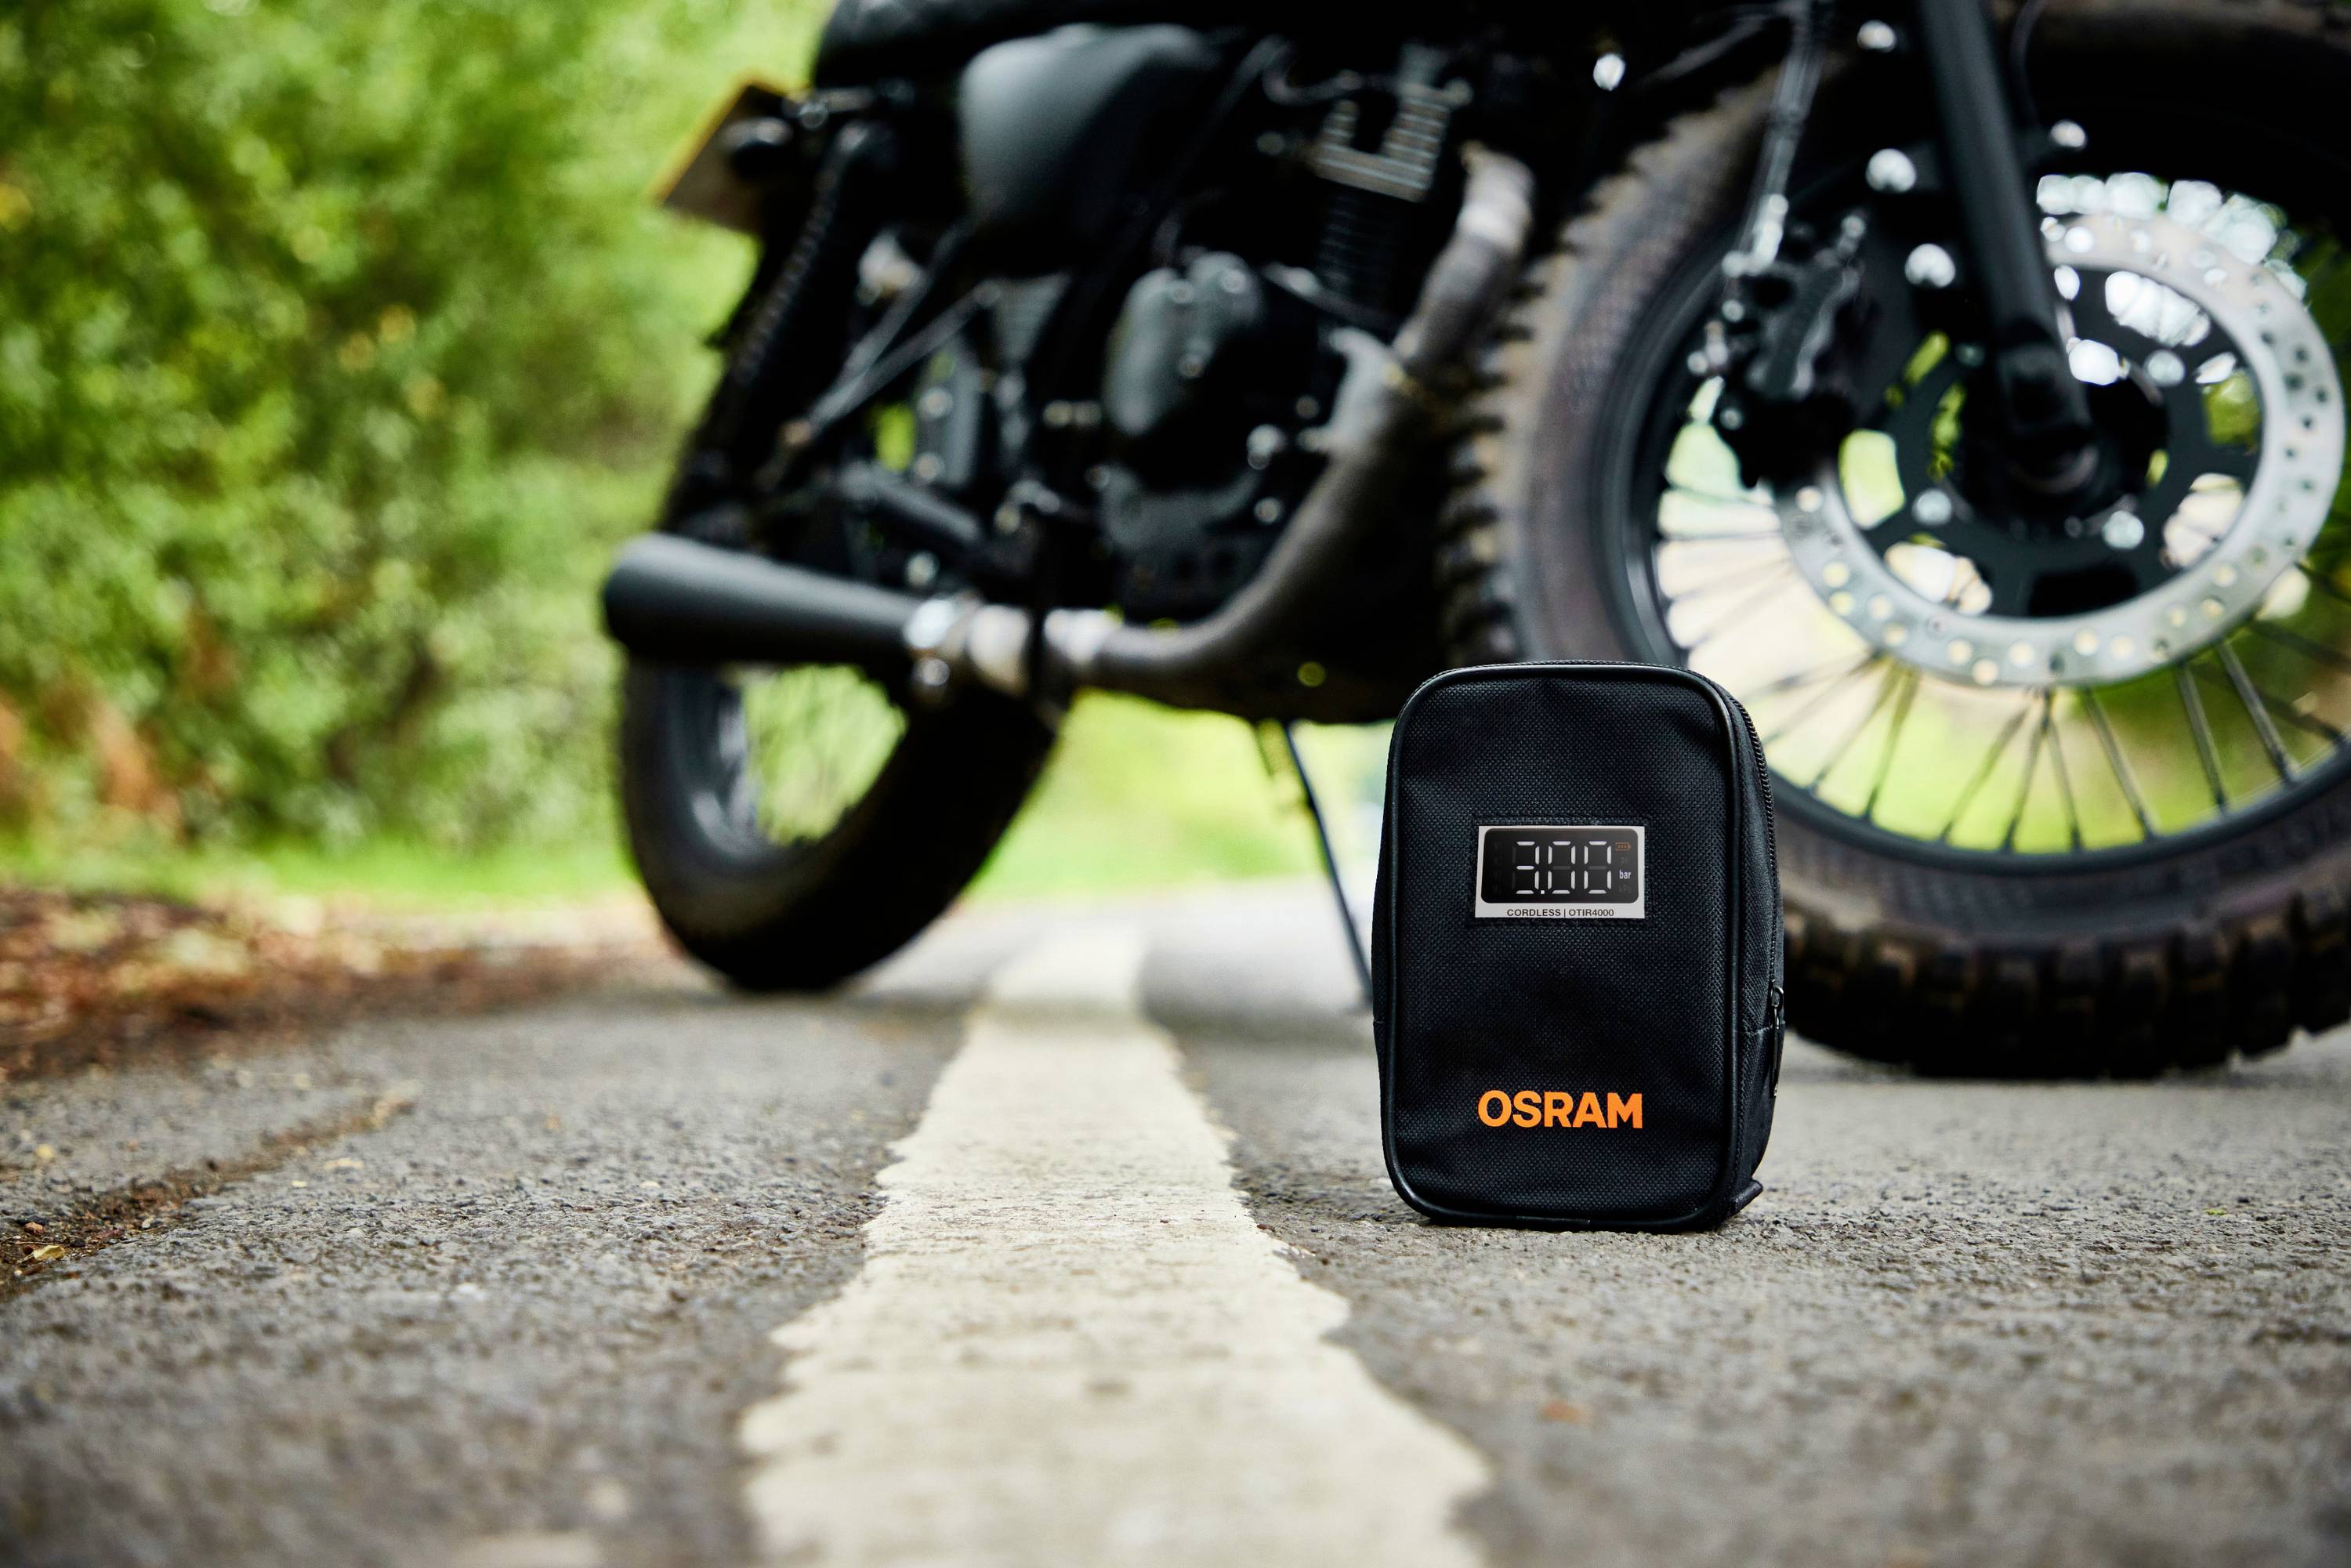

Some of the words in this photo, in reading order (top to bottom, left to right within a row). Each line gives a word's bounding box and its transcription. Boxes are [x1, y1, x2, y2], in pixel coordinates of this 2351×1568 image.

[1516, 841, 1612, 895] 3.00
[1619, 870, 1632, 879] bar
[1478, 1090, 1643, 1128] OSRAM
